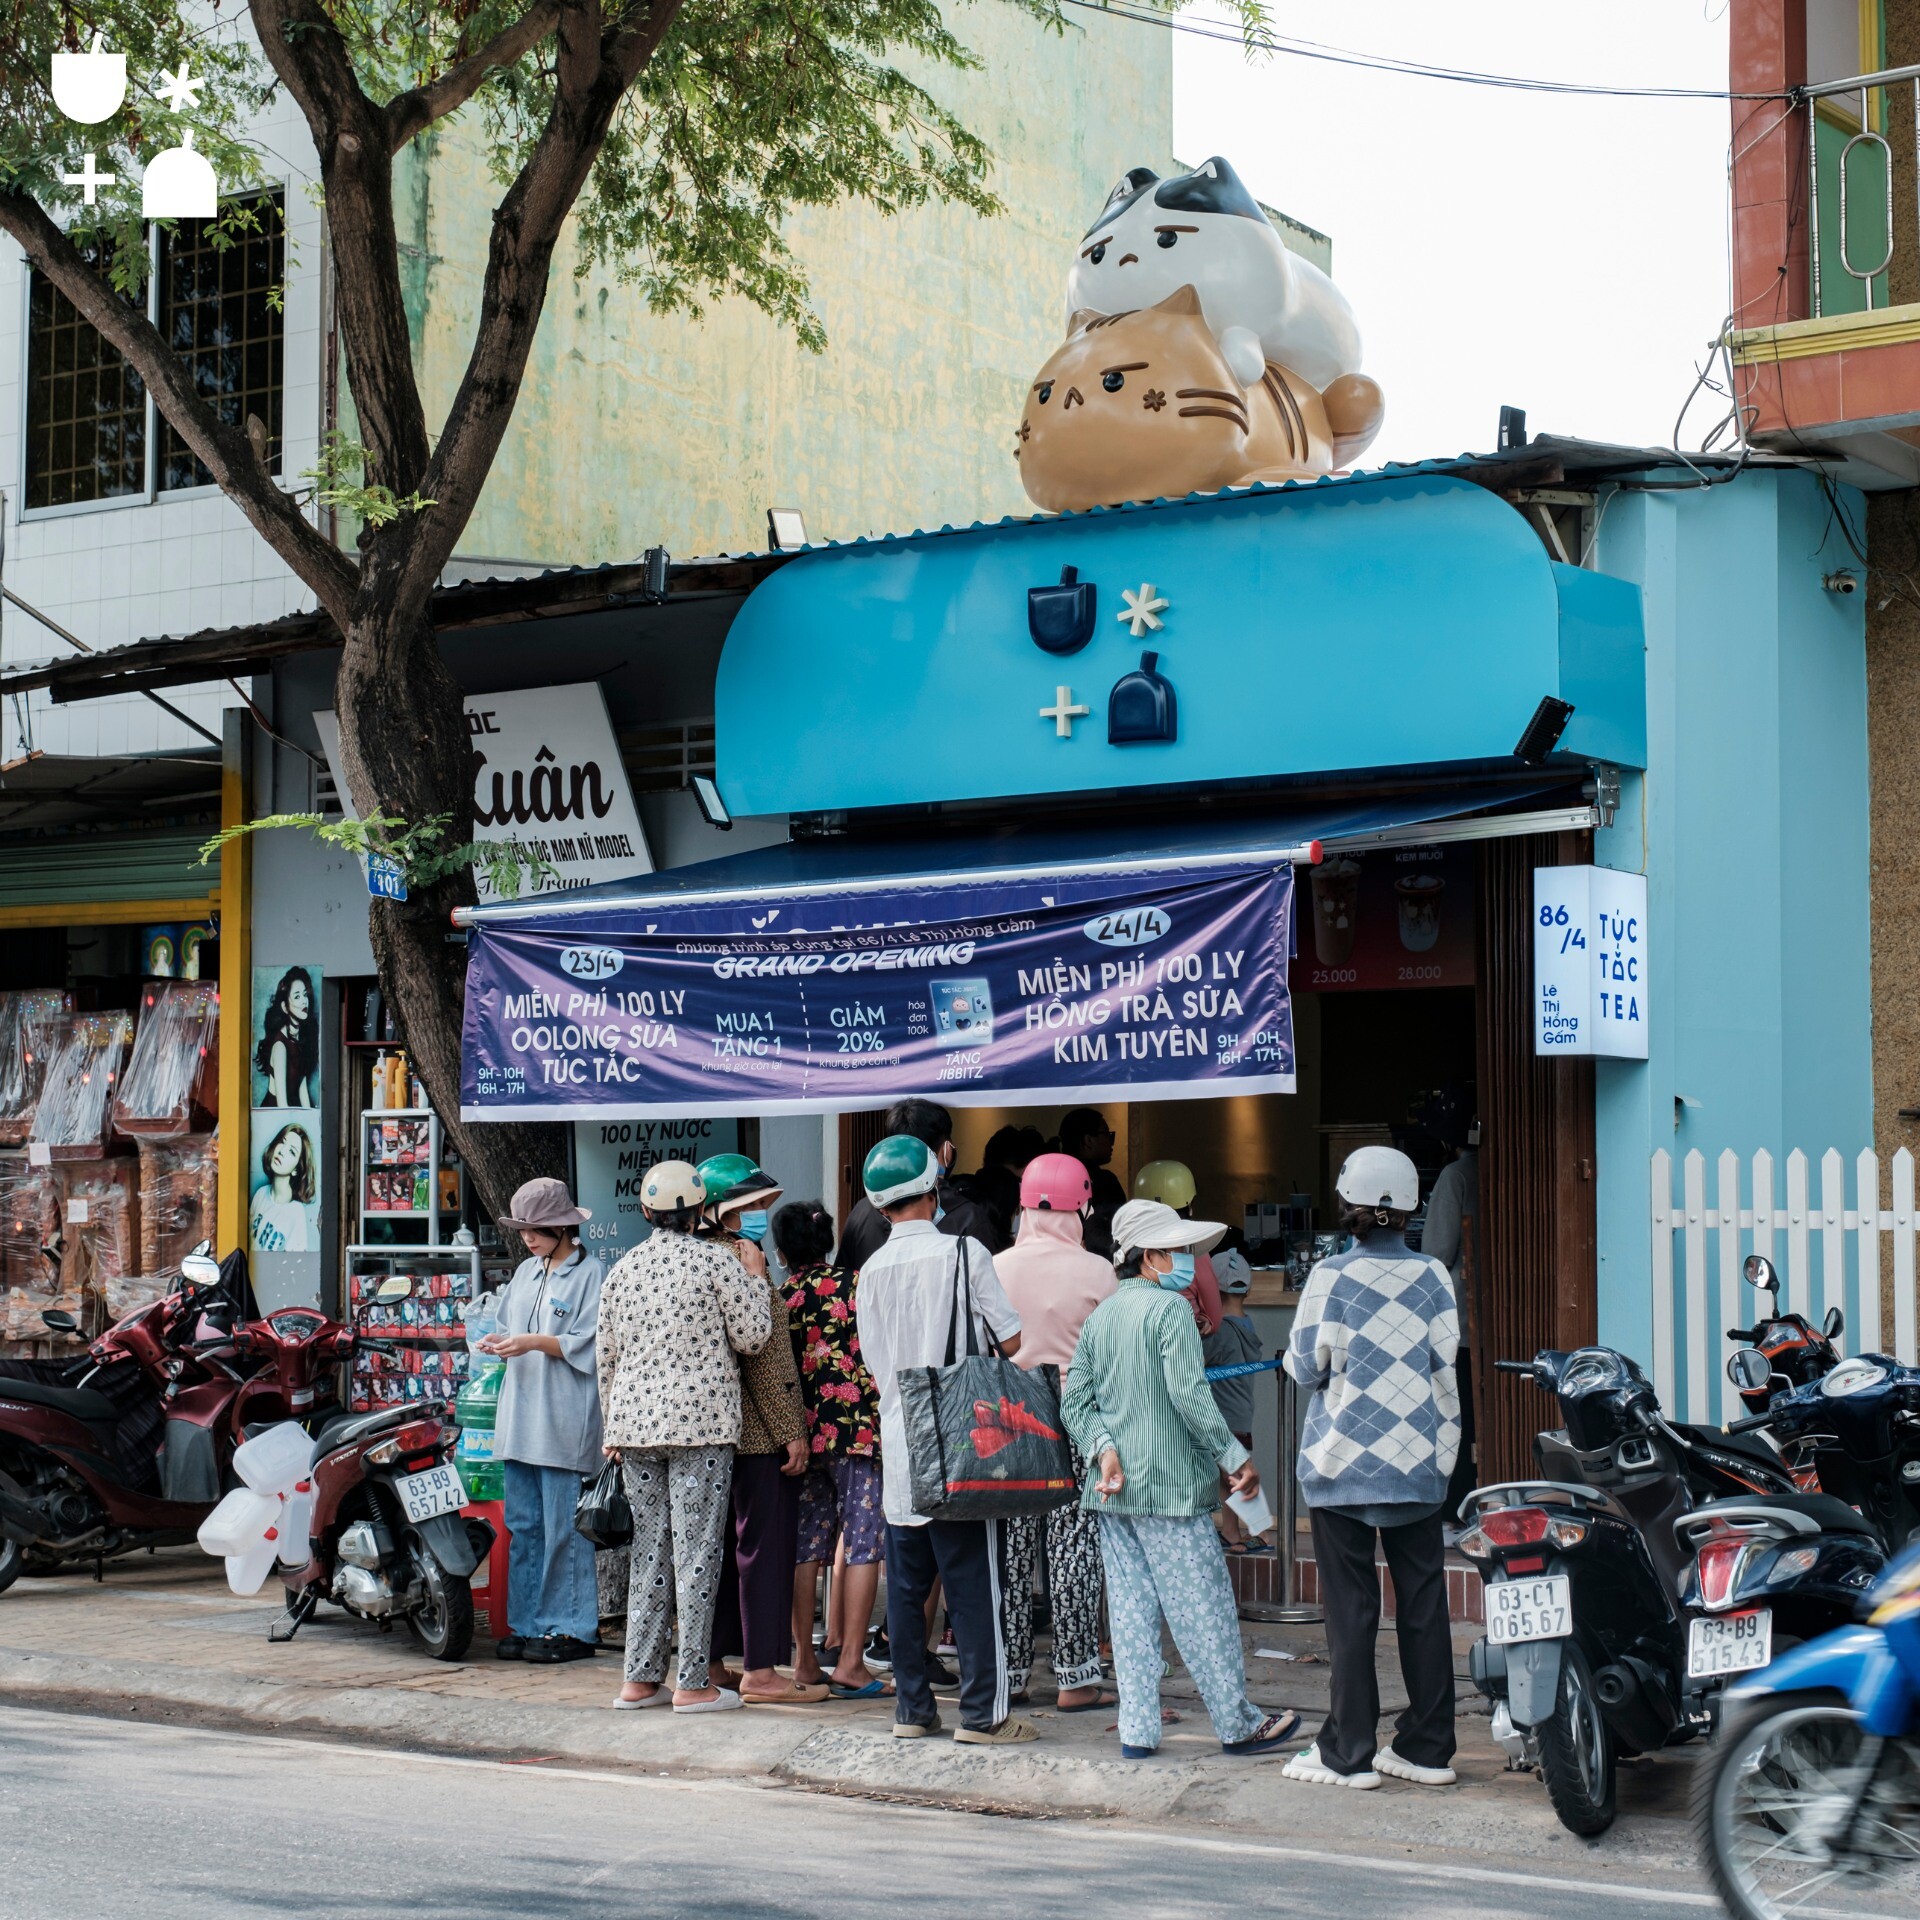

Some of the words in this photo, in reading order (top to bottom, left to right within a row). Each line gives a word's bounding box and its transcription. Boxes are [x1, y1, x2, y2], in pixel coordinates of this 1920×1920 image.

[550, 839, 579, 862] NAM
[577, 832, 595, 861] NỮ
[594, 834, 635, 859] MODEL
[1097, 910, 1162, 942] 24/4
[1539, 904, 1569, 927] 86
[1600, 908, 1638, 943] TÚC
[1560, 928, 1585, 954] /4
[567, 949, 617, 977] 23/4
[713, 954, 825, 979] GRAND
[830, 941, 976, 974] OPENING
[1018, 957, 1091, 996] MIỄN
[1101, 952, 1145, 990] PHÍ
[1156, 953, 1203, 984] 100
[1211, 950, 1245, 980] LY
[1397, 966, 1441, 980] 28.000
[1312, 969, 1357, 984] 25.000
[504, 985, 560, 1019] MIỄN
[567, 986, 608, 1017] PHÍ
[616, 991, 655, 1017] 100
[660, 990, 686, 1015] LY
[1543, 984, 1558, 997] Lê
[830, 1001, 886, 1028] GIẢM
[908, 1001, 926, 1010] hóa
[909, 1013, 927, 1023] đơn
[1025, 992, 1111, 1031] HỒNG
[1120, 986, 1175, 1023] TRÀ
[1182, 984, 1244, 1019] SỮA
[1542, 1000, 1560, 1014] Thị
[1600, 992, 1640, 1021] TEA
[716, 1012, 763, 1033] MUA
[764, 1011, 774, 1031] 1
[907, 1026, 929, 1035] 100k
[1543, 1012, 1578, 1030] Hồng
[511, 1024, 622, 1052] OOLONG
[627, 1019, 678, 1049] SỮA
[711, 1033, 768, 1062] TẶNG
[773, 1036, 782, 1055] 1
[837, 1031, 885, 1053] 20%
[1054, 1034, 1108, 1064] KIM
[1115, 1024, 1208, 1060] TUYÊN
[1217, 1034, 1239, 1048] 9H
[1251, 1031, 1279, 1045] 10H
[1543, 1029, 1577, 1044] Gấm
[542, 1052, 588, 1084] TÚC
[593, 1048, 641, 1083] TẮC
[701, 1061, 732, 1072] khung
[751, 1061, 770, 1070] còn
[820, 1058, 849, 1068] khung
[868, 1056, 887, 1066] còn
[1216, 1051, 1241, 1065] 16H
[1254, 1048, 1282, 1061] 17H
[478, 1067, 494, 1079] 9H
[503, 1067, 525, 1079] 10H
[936, 1066, 984, 1081] JIBBITZ
[476, 1082, 497, 1094] 16H
[506, 1082, 525, 1093] 17H
[601, 1124, 631, 1144] 100
[636, 1122, 657, 1142] LY
[618, 1142, 663, 1170] MIỄN
[615, 1169, 641, 1197] MỖ
[589, 1221, 617, 1240] 86/4
[409, 1488, 464, 1518] 657.42
[1498, 1582, 1555, 1612] 63-C1
[1493, 1607, 1565, 1640] 065.67
[1702, 1615, 1757, 1645] 63-B9
[1694, 1640, 1765, 1673] 515.43
